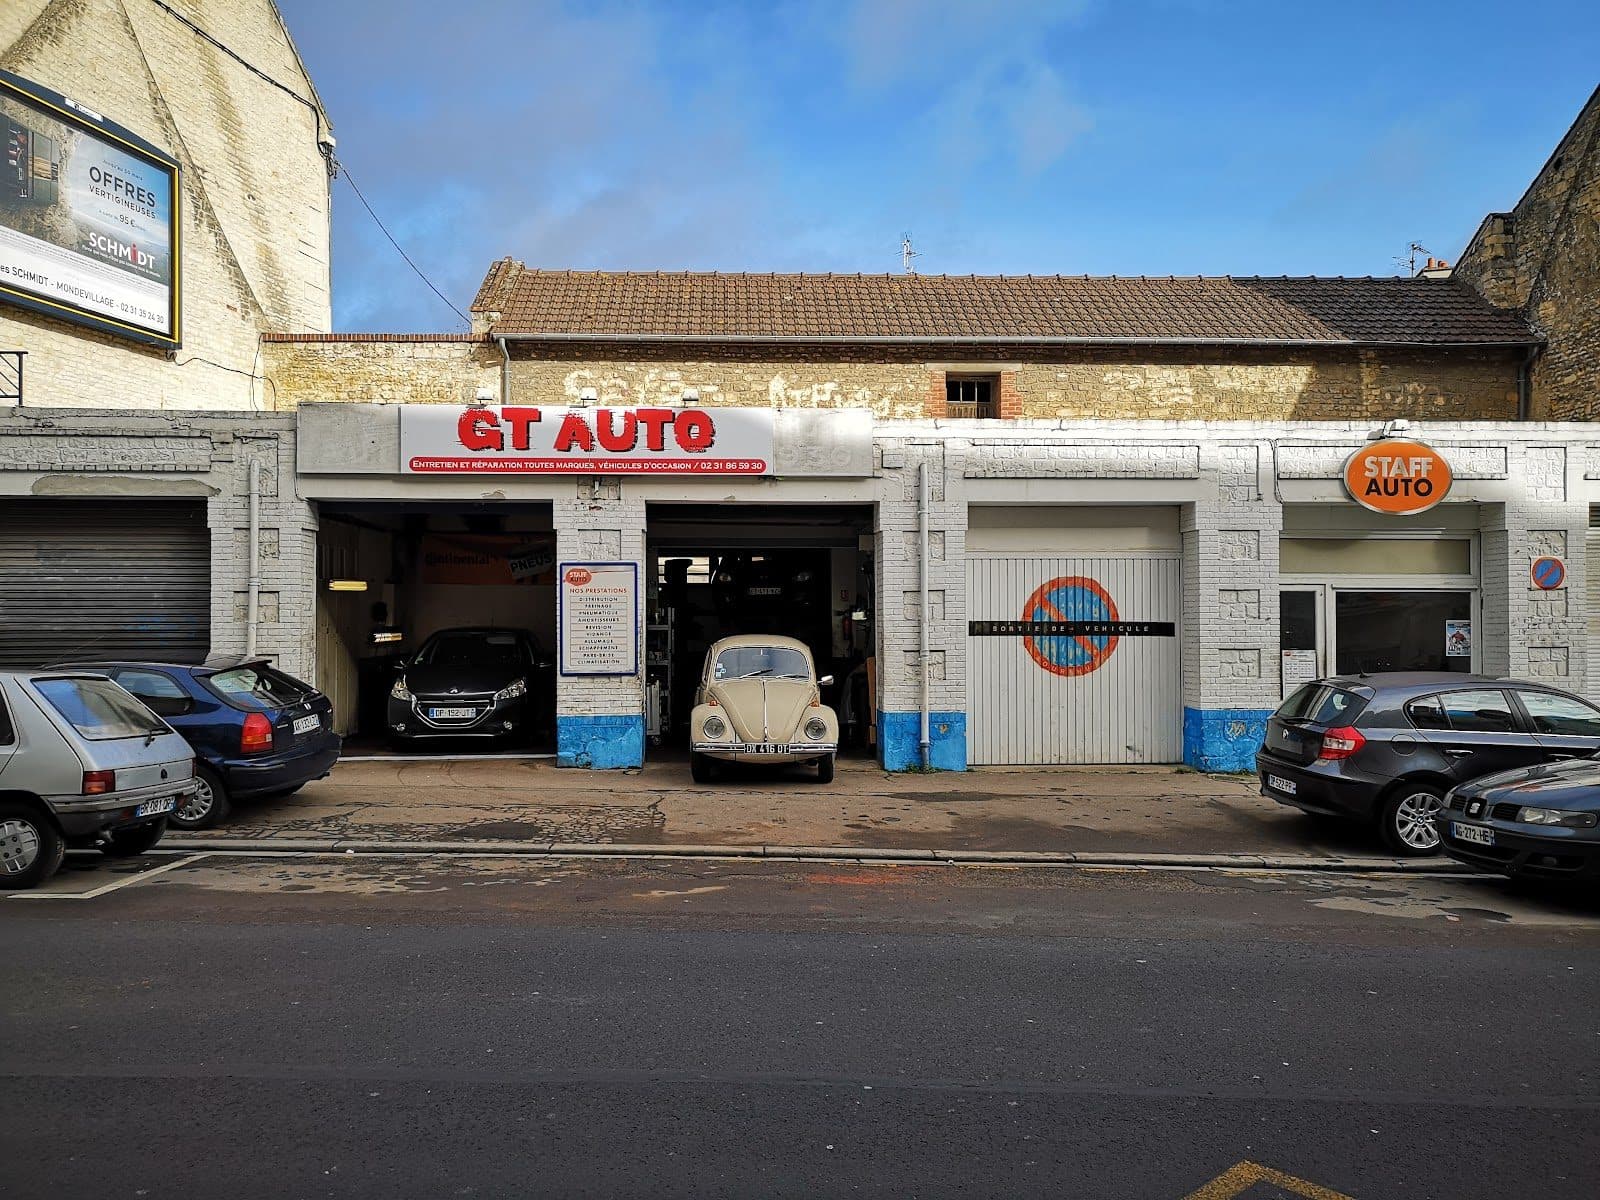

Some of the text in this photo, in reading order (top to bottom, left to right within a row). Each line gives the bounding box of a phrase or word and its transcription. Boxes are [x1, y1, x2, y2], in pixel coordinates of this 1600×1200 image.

[89, 166, 156, 208] OFFRES
[89, 184, 156, 219] VERTIGINEUSES
[119, 214, 129, 225] 95
[12, 266, 49, 287] SCHMIDT
[56, 282, 114, 308] MONDEVILLAGE
[120, 302, 129, 313] 02
[130, 305, 137, 316] 31
[139, 307, 147, 318] 35
[457, 406, 717, 453] GT AUTO
[471, 460, 523, 469] RÉPARATION
[599, 460, 642, 469] VÉHICULES
[643, 461, 692, 470] D'OCCASION
[701, 462, 712, 470] 02
[712, 462, 723, 470] 31
[725, 462, 738, 470] 86
[738, 462, 750, 470] 59
[751, 462, 763, 470] 30
[1364, 456, 1433, 478] STAFF
[1364, 478, 1433, 497] AUTO
[510, 552, 553, 573] PNEUS
[746, 744, 757, 753] DX
[759, 744, 775, 753] 416
